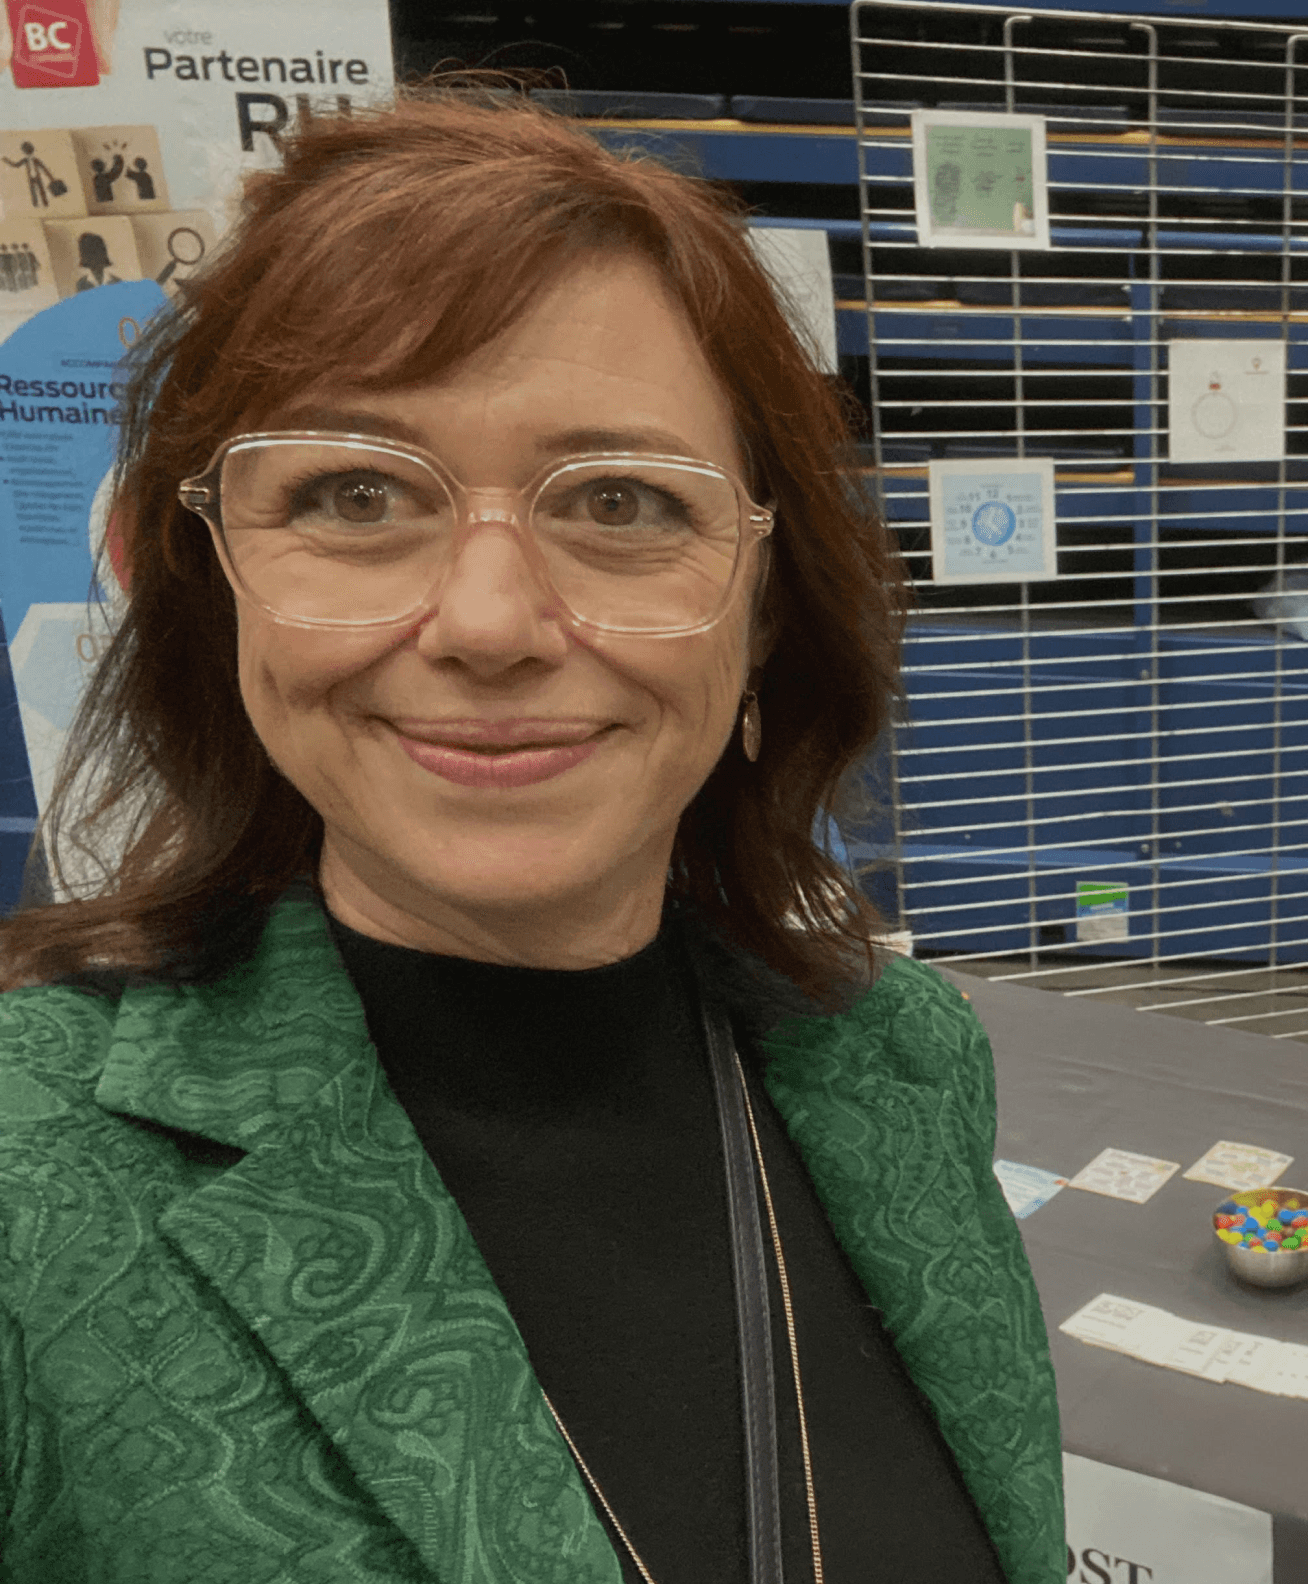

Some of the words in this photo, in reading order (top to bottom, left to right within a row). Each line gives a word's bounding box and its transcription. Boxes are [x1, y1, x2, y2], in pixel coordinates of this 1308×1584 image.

[25, 22, 71, 51] BC
[164, 28, 214, 45] votre
[143, 47, 370, 85] Partenaire
[0, 374, 128, 399] Ressourc
[0, 400, 124, 426] Humaine
